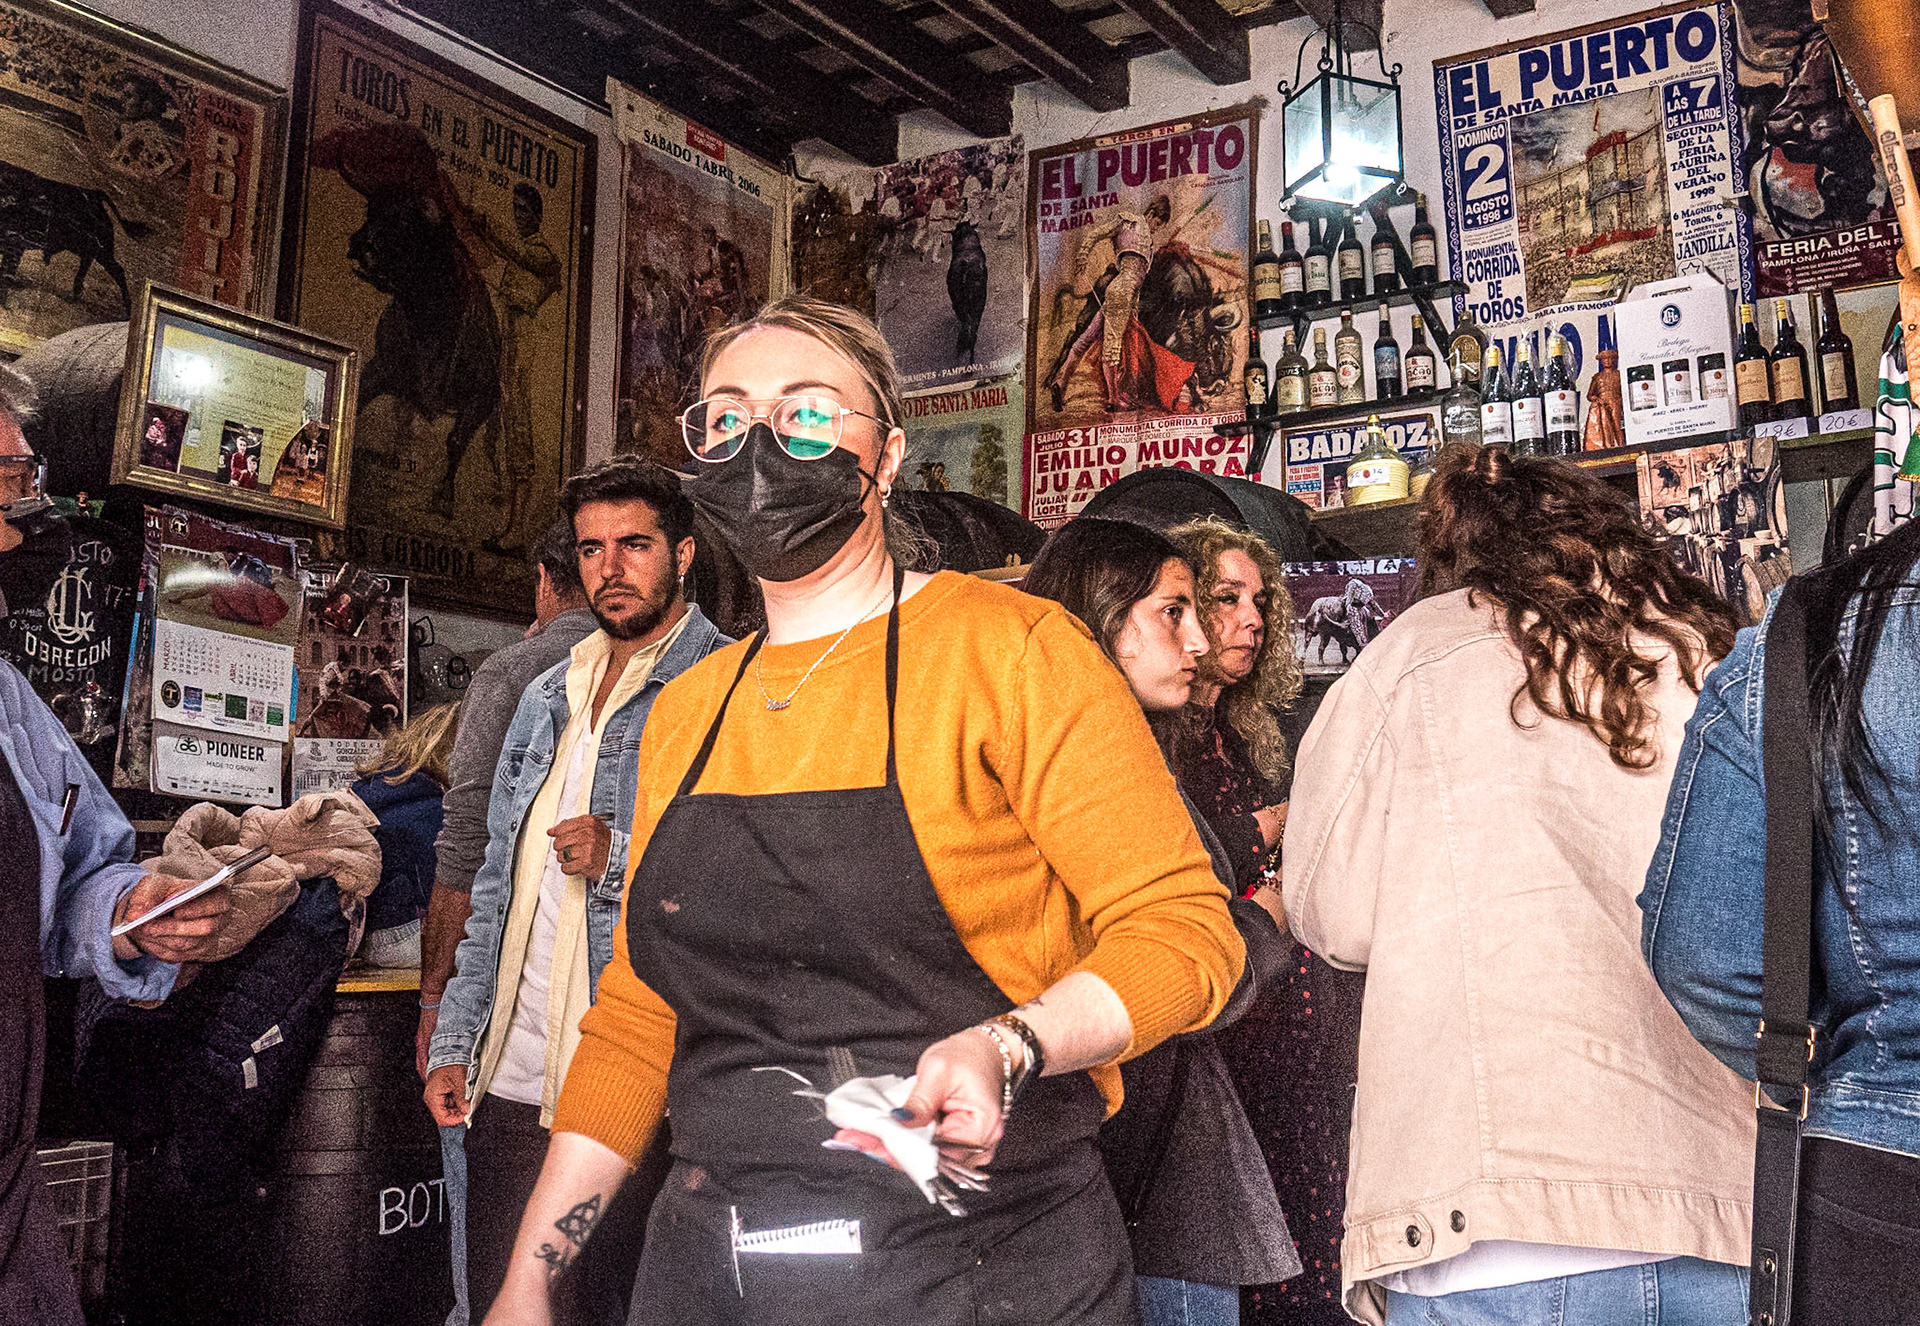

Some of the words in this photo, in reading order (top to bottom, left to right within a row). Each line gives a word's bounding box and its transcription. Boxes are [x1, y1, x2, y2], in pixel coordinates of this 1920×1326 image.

[1450, 63, 1501, 116] EL
[1519, 11, 1717, 100] PUERTO
[1672, 85, 1681, 97] A
[1689, 77, 1716, 108] 7
[1453, 113, 1477, 130] DE
[1484, 100, 1544, 123] SANTA
[1552, 82, 1619, 106] MARIA
[1666, 97, 1688, 113] LAS
[204, 108, 248, 135] ROJAS
[339, 48, 411, 121] TOROS
[421, 103, 442, 137] EN
[452, 117, 470, 149] EL
[480, 116, 558, 188] PUERTO
[1667, 116, 1678, 129] DE
[1680, 112, 1692, 125] LA
[1693, 107, 1721, 122] TARDE
[1113, 130, 1154, 144] TOROS
[1158, 126, 1176, 136] EN
[1457, 124, 1505, 149] DOMINGO
[1666, 122, 1726, 142] SEGUNDA
[1678, 139, 1694, 149] DE
[1698, 134, 1714, 144] LA
[1678, 144, 1716, 159] FERIA
[643, 129, 691, 162] SABADO
[695, 154, 700, 167] 1
[702, 160, 736, 184] ABRIL
[738, 176, 761, 197] 2006
[1041, 156, 1082, 200] EL
[1097, 125, 1244, 192] PUERTO
[1464, 143, 1507, 201] 2
[1670, 152, 1726, 172] TAURINA
[1687, 165, 1710, 178] DEL
[1674, 172, 1726, 191] VERANO
[1690, 185, 1715, 200] 1998
[1040, 202, 1062, 217] DE
[1070, 192, 1119, 215] SANTA
[1464, 194, 1509, 217] AGOSTO
[1476, 212, 1500, 226] 1998
[1673, 212, 1679, 220] 6
[1716, 212, 1723, 220] 6
[1465, 241, 1517, 261] MONUMENTAL
[1676, 232, 1736, 260] JANDILLA
[1766, 236, 1832, 258] FERIA
[1838, 225, 1882, 246] DEL
[1762, 254, 1819, 268] PAMPLONA
[1827, 245, 1860, 258] IRUÑA
[1868, 240, 1890, 250] SAN
[1466, 253, 1520, 283] CORRIDA
[1488, 280, 1503, 300] DE
[1469, 296, 1524, 325] TOROS
[1534, 310, 1555, 320] PARA
[1558, 304, 1574, 313] LOS
[942, 364, 982, 378] PAMPLONA
[914, 398, 929, 417] DE
[932, 392, 968, 414] SANTA
[971, 387, 1008, 409] MARIA
[1100, 420, 1155, 435] MONUMENTAL
[1158, 417, 1199, 430] CORRIDA
[1202, 416, 1213, 425] DE
[1216, 413, 1245, 424] TOROS
[1825, 414, 1859, 431] 20€
[1037, 432, 1065, 444] SABADO
[1040, 442, 1063, 451] JULIO
[1067, 427, 1096, 447] 31
[1289, 422, 1428, 462] BADAOZ
[1036, 445, 1127, 474] EMILIO
[1035, 468, 1120, 495] JUAN
[1035, 494, 1067, 506] JULIAN
[1037, 505, 1067, 515] LOPEZ
[25, 631, 111, 667] OBREGON
[163, 641, 171, 670] MARZO
[27, 665, 96, 683] MOSTO
[206, 740, 264, 761] PIONEER
[207, 761, 223, 769] MADE
